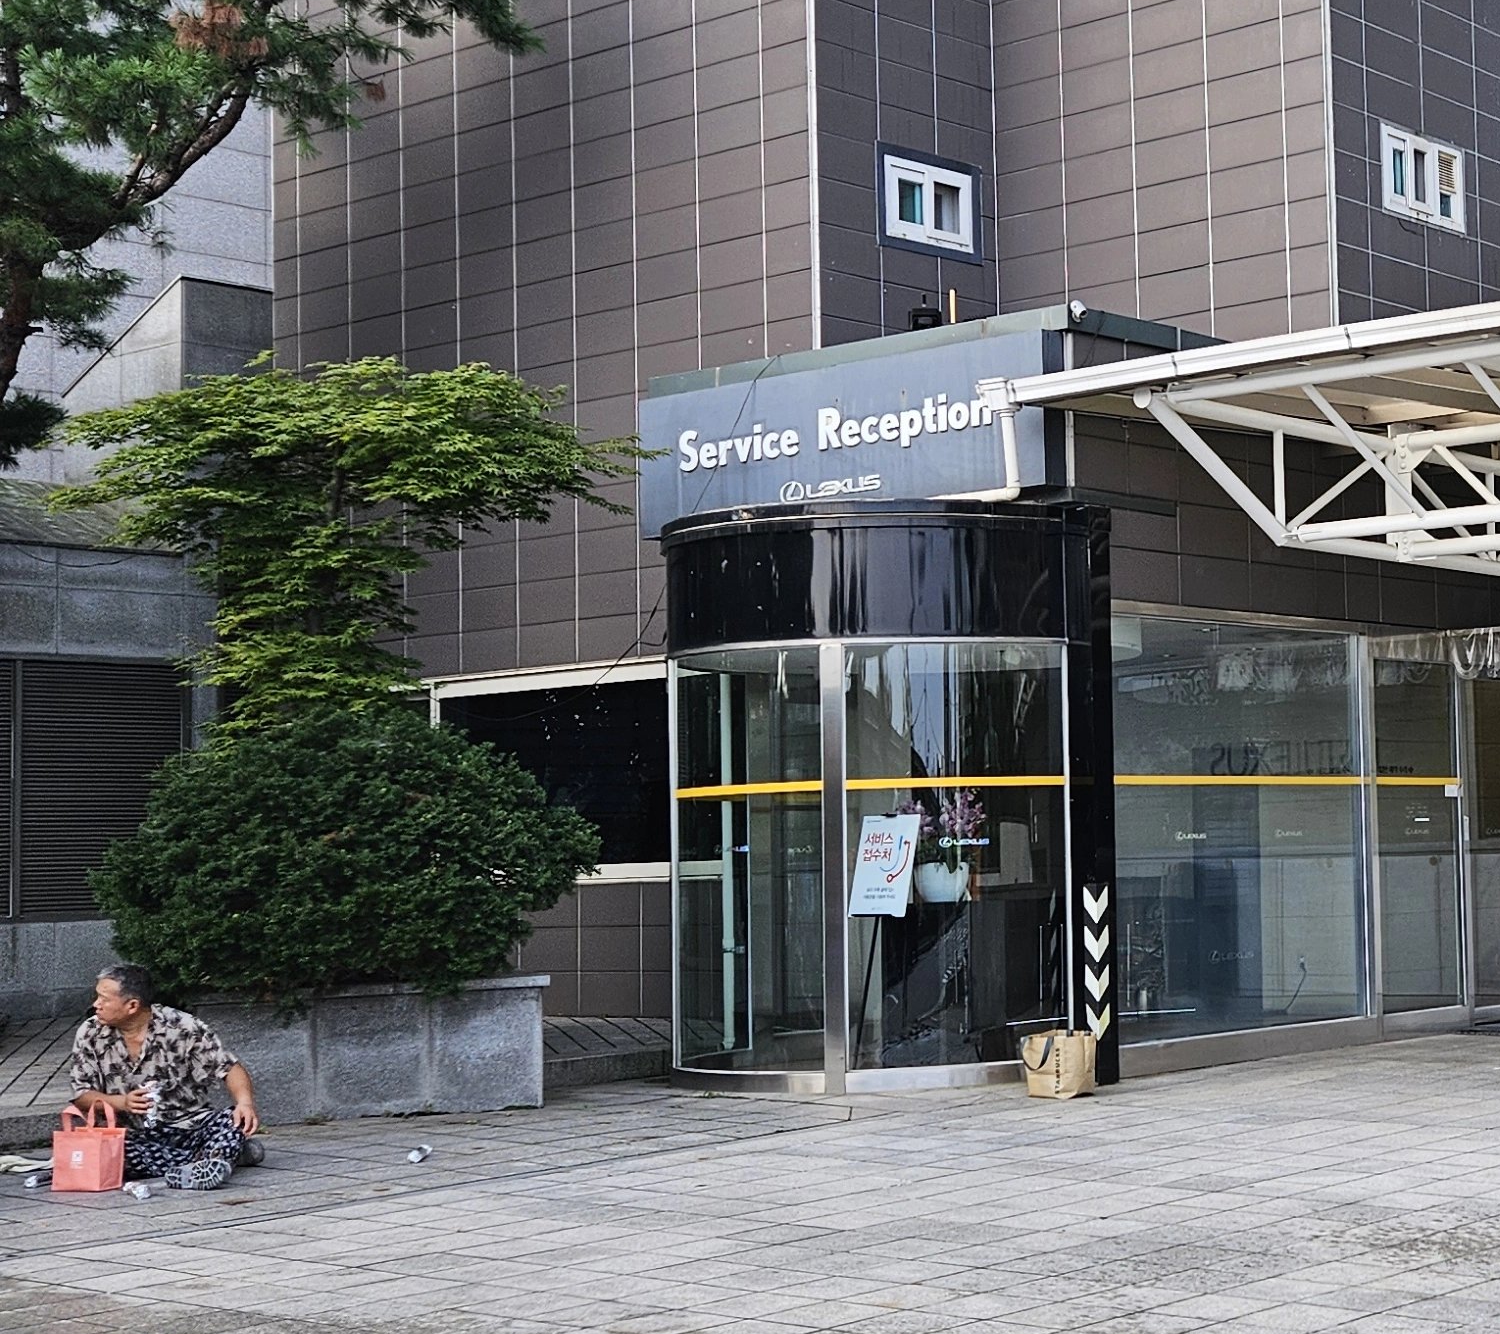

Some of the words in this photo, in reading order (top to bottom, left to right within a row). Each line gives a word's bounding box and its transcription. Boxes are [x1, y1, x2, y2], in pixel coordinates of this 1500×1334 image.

[678, 423, 800, 473] Service
[818, 394, 993, 448] Reception
[805, 474, 881, 499] LEXUS
[865, 832, 894, 846] 서비스
[863, 848, 892, 862] 접수처
